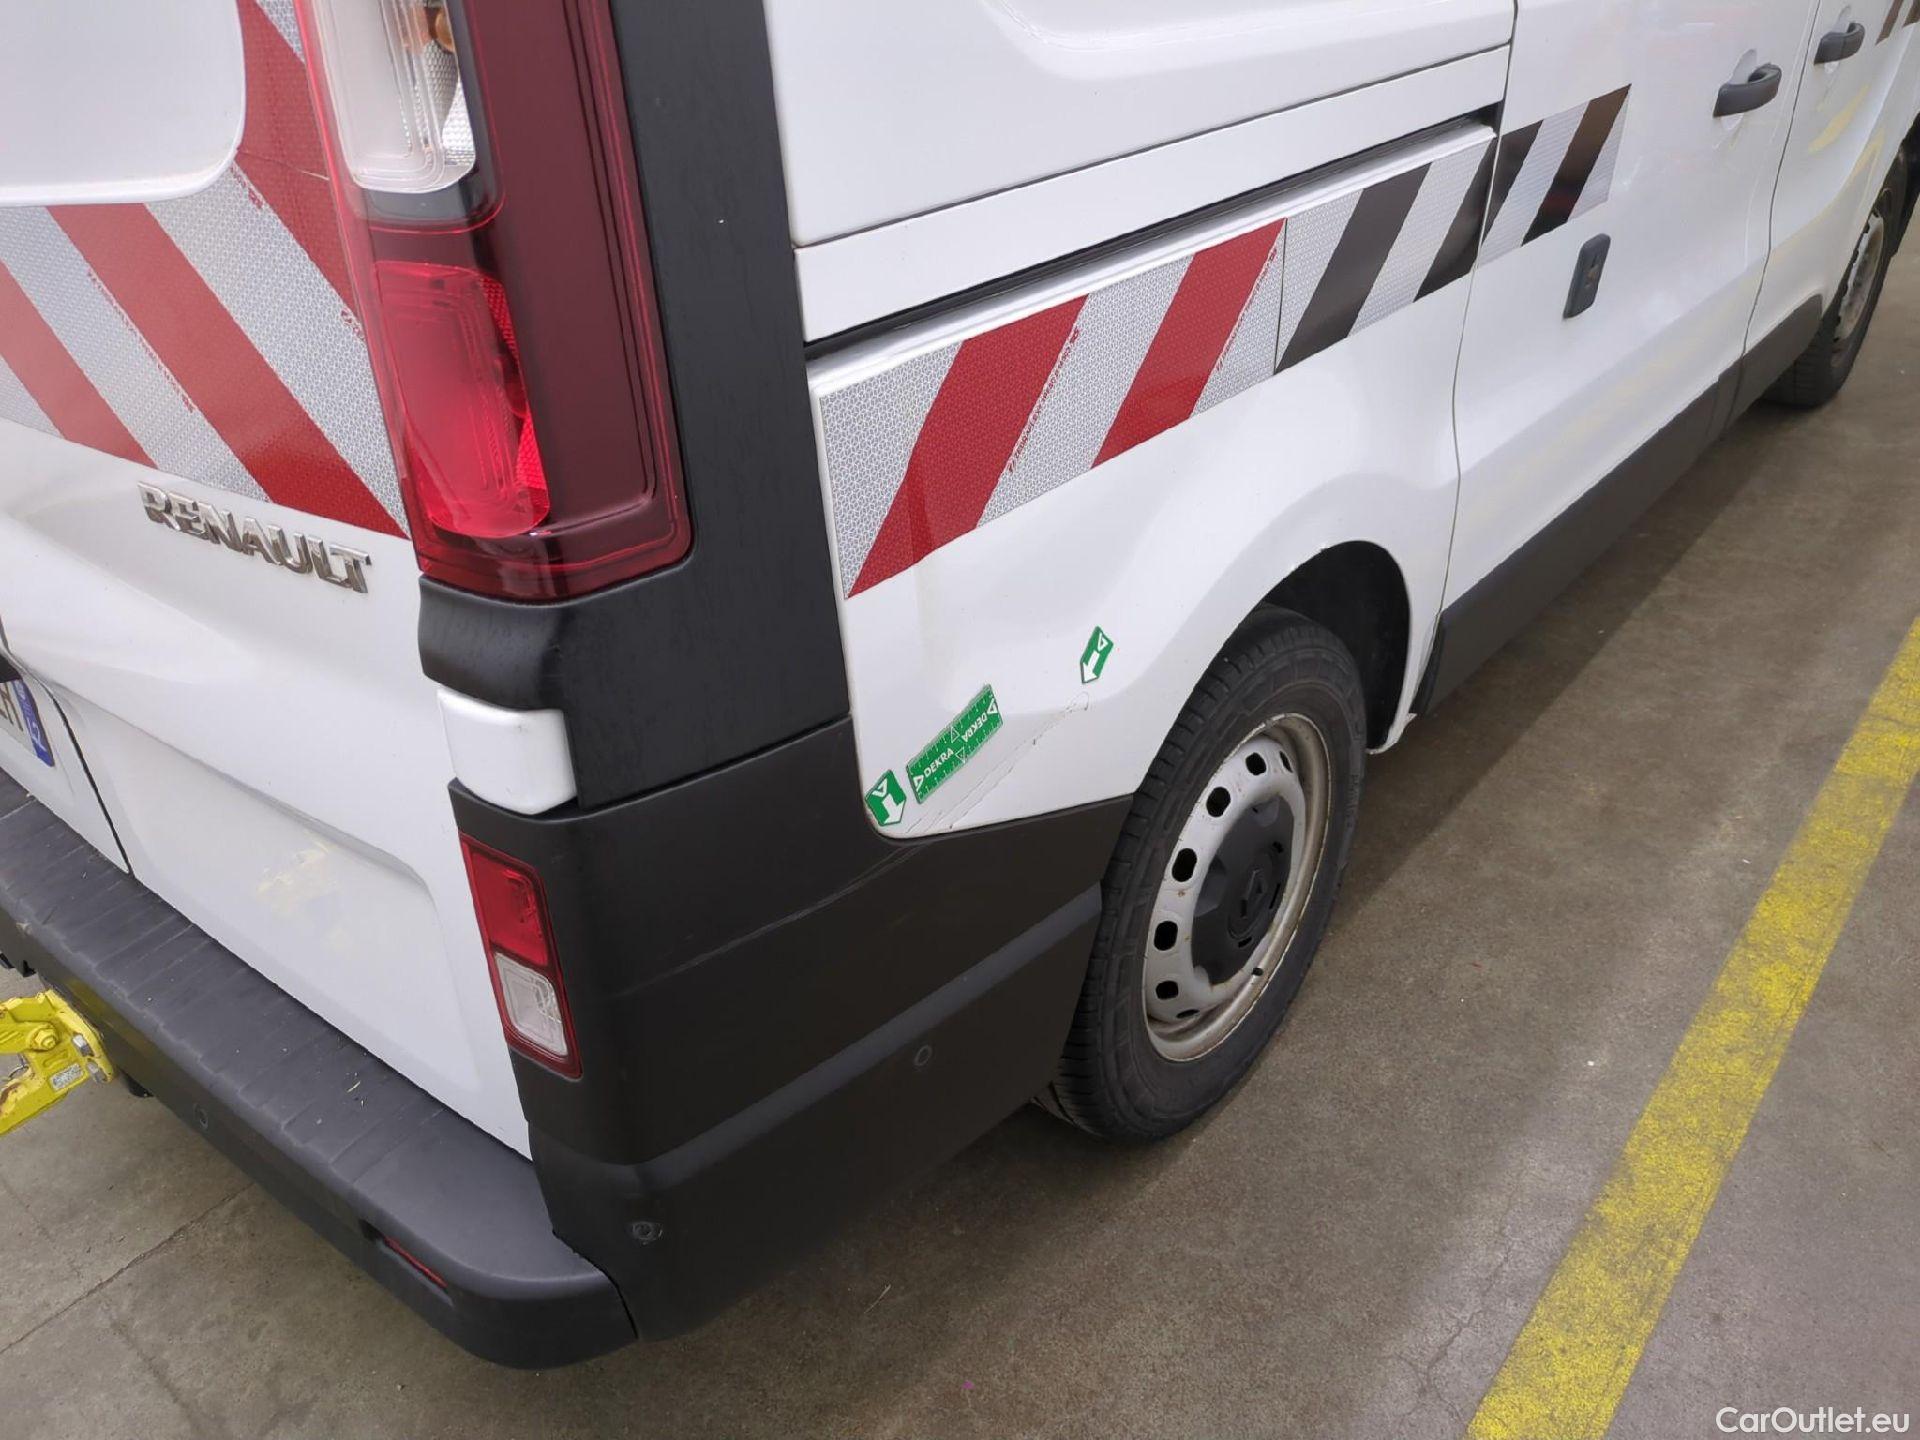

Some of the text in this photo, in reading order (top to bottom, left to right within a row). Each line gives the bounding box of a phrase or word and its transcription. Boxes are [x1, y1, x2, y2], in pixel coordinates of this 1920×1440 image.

[138, 481, 371, 593] RENAULT
[961, 712, 988, 742] DEKRA
[923, 748, 954, 777] DEKRA
